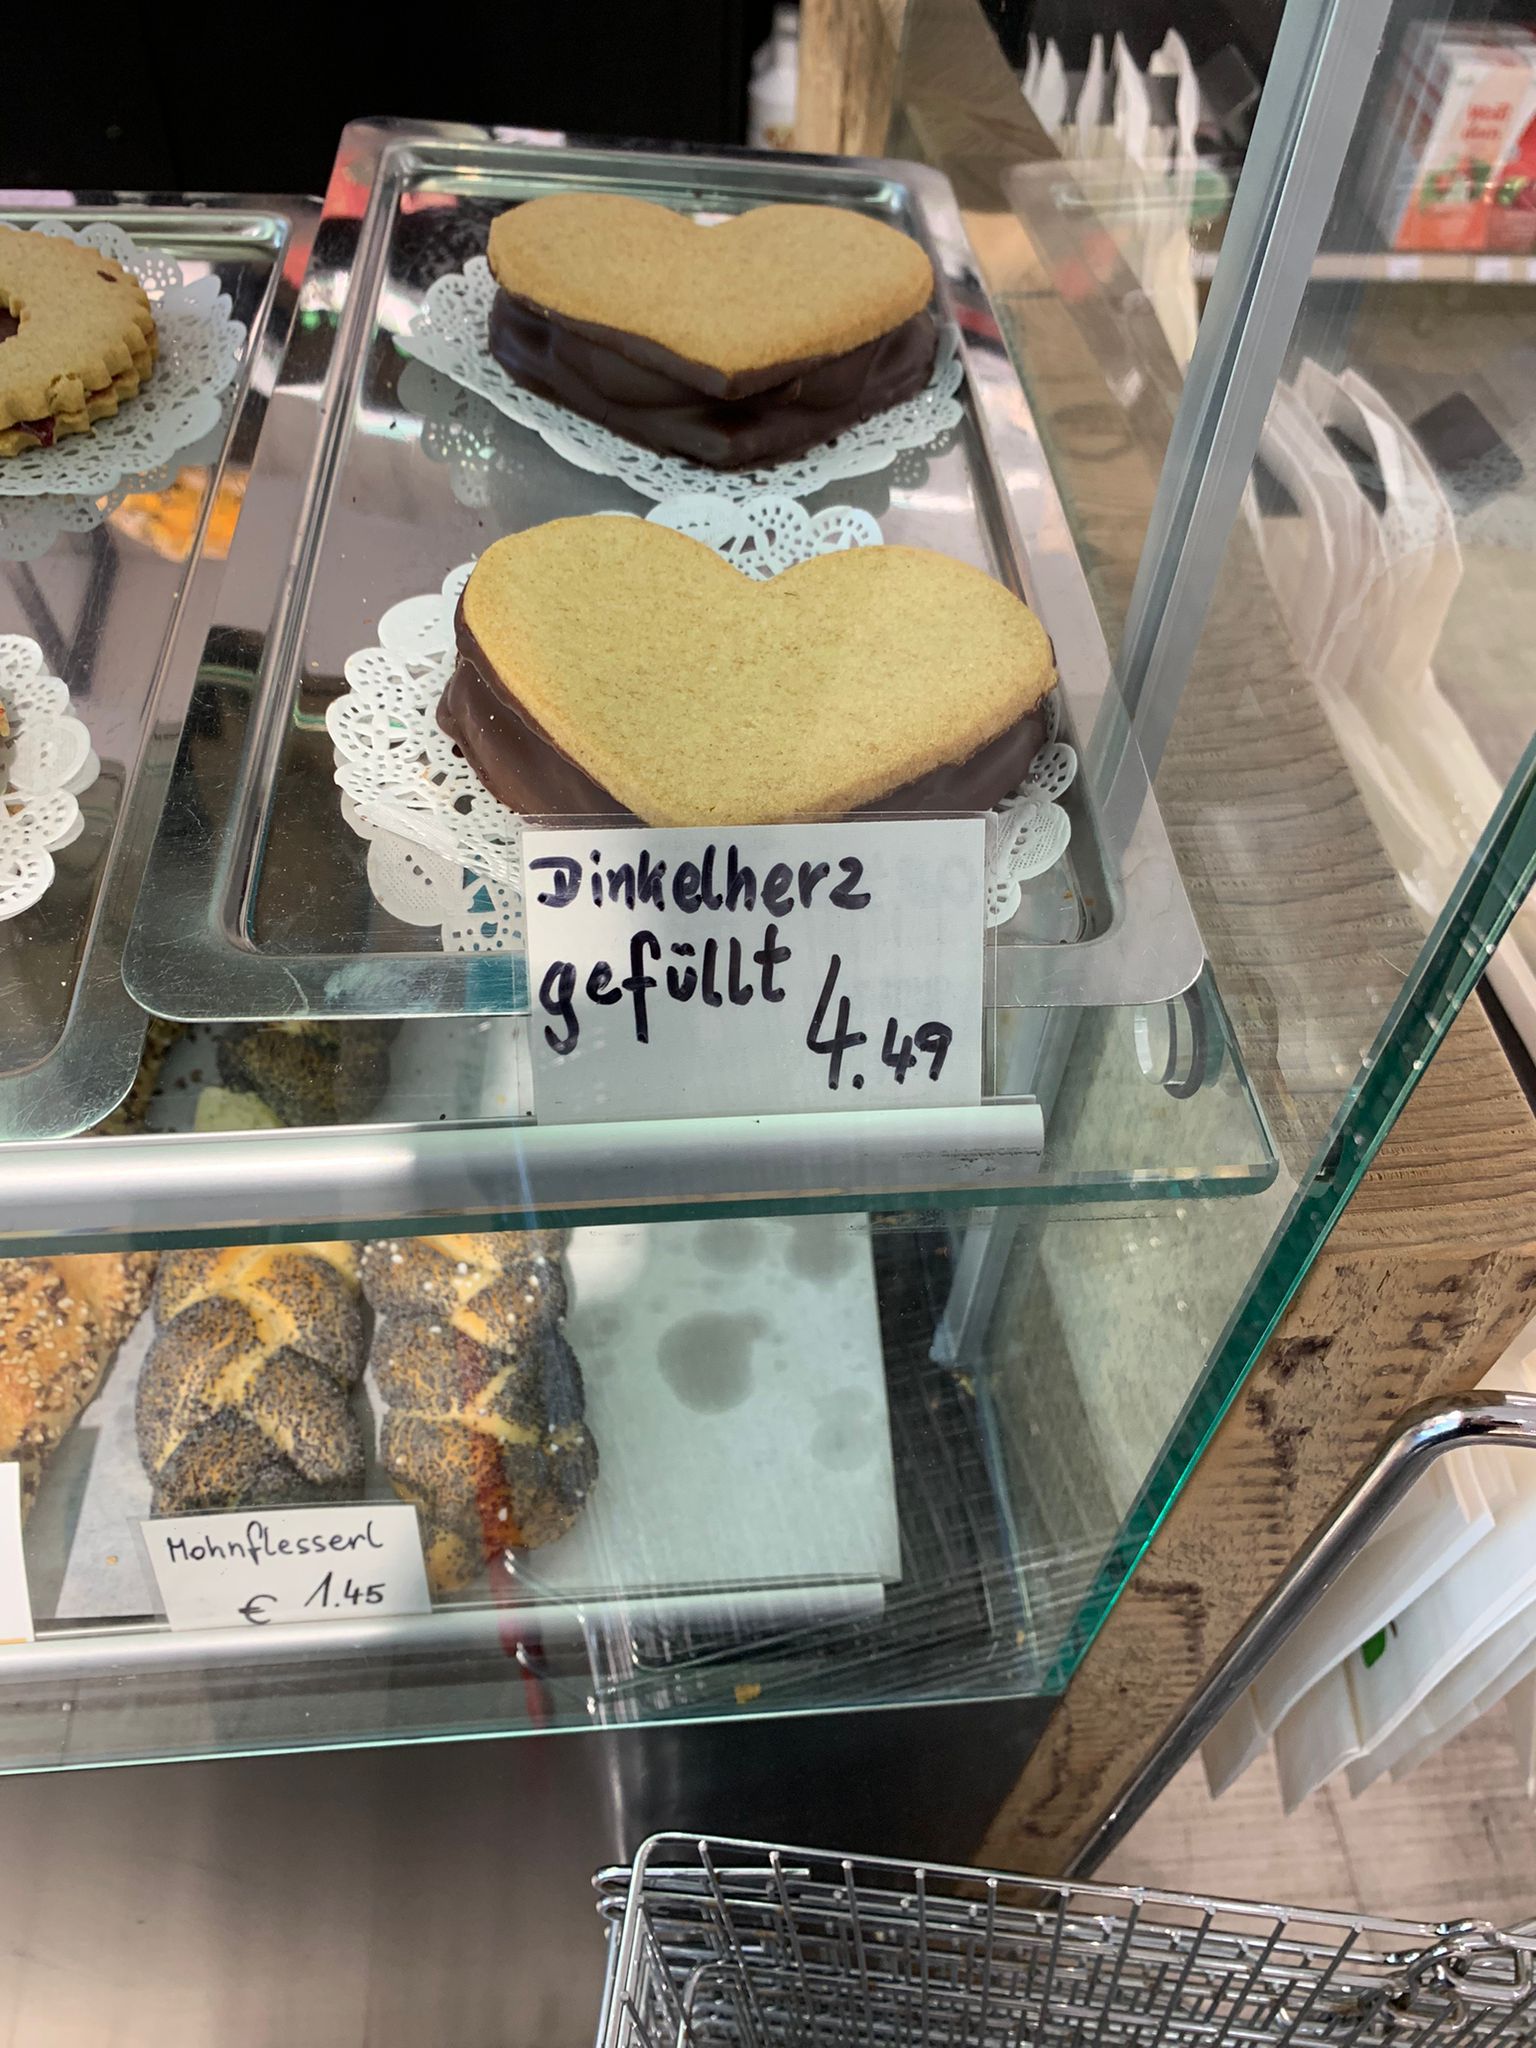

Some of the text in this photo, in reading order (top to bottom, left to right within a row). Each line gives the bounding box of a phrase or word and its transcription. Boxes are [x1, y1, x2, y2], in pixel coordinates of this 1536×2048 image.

[529, 844, 871, 917] Dinkelherz
[539, 923, 792, 1055] gefüllt
[806, 953, 952, 1090] 4.49
[167, 1520, 384, 1565] Mohnflesserl
[238, 1571, 386, 1625] € 1.45
